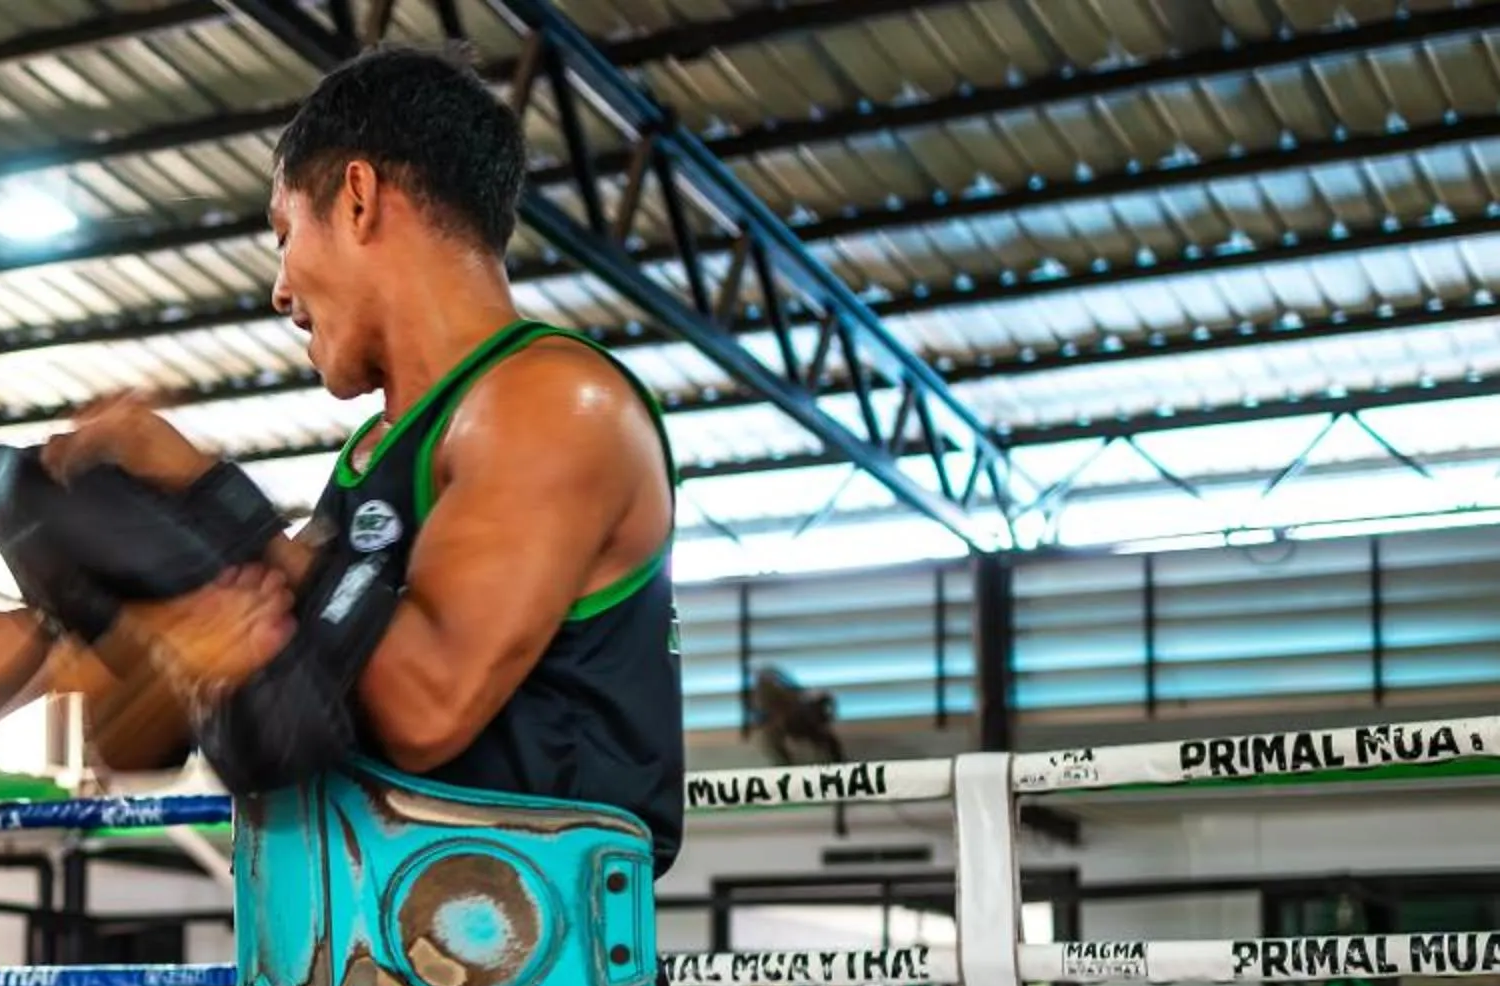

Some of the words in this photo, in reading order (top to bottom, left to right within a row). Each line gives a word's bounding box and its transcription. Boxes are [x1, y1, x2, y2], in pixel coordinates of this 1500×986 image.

[1180, 734, 1344, 778] PRIMAL
[1356, 724, 1484, 763] MUA
[1067, 943, 1144, 959] MAGMA
[1232, 936, 1398, 979] PRIMAL
